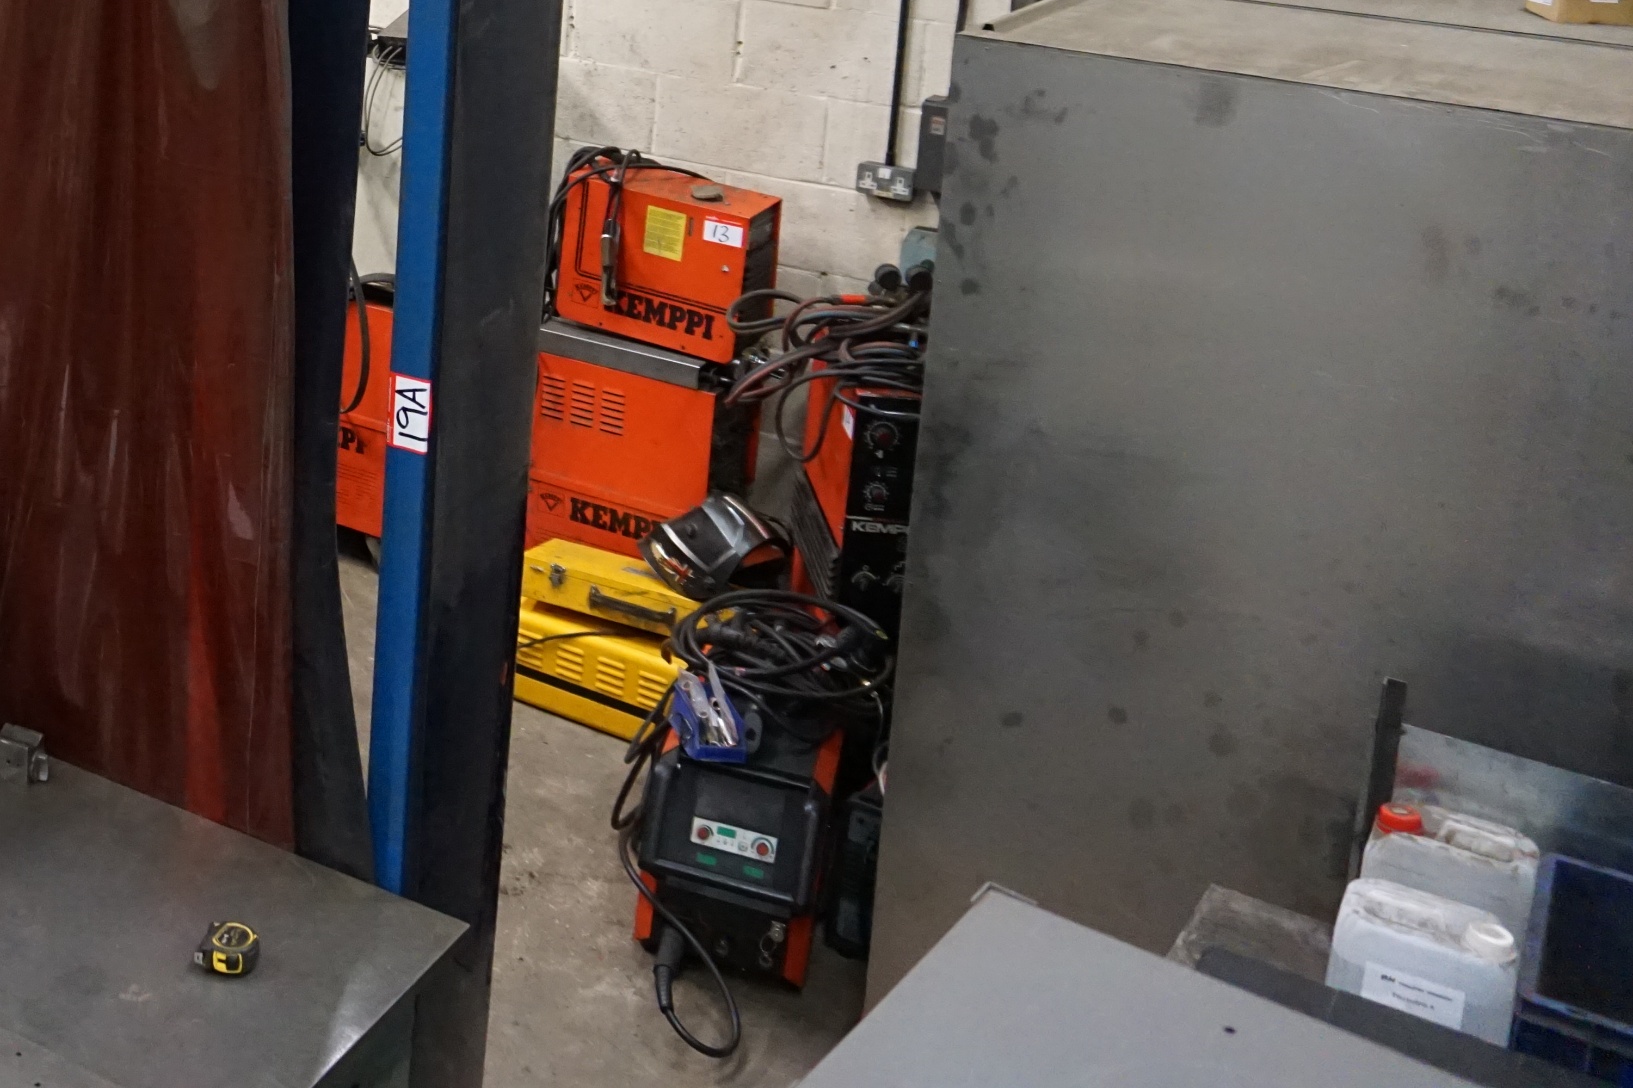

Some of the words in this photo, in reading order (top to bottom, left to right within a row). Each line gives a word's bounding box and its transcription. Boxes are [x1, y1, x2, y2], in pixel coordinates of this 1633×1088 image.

[712, 225, 729, 243] 13
[395, 388, 428, 442] 19A
[570, 497, 662, 540] KEMP
[852, 521, 909, 535] KEMP
